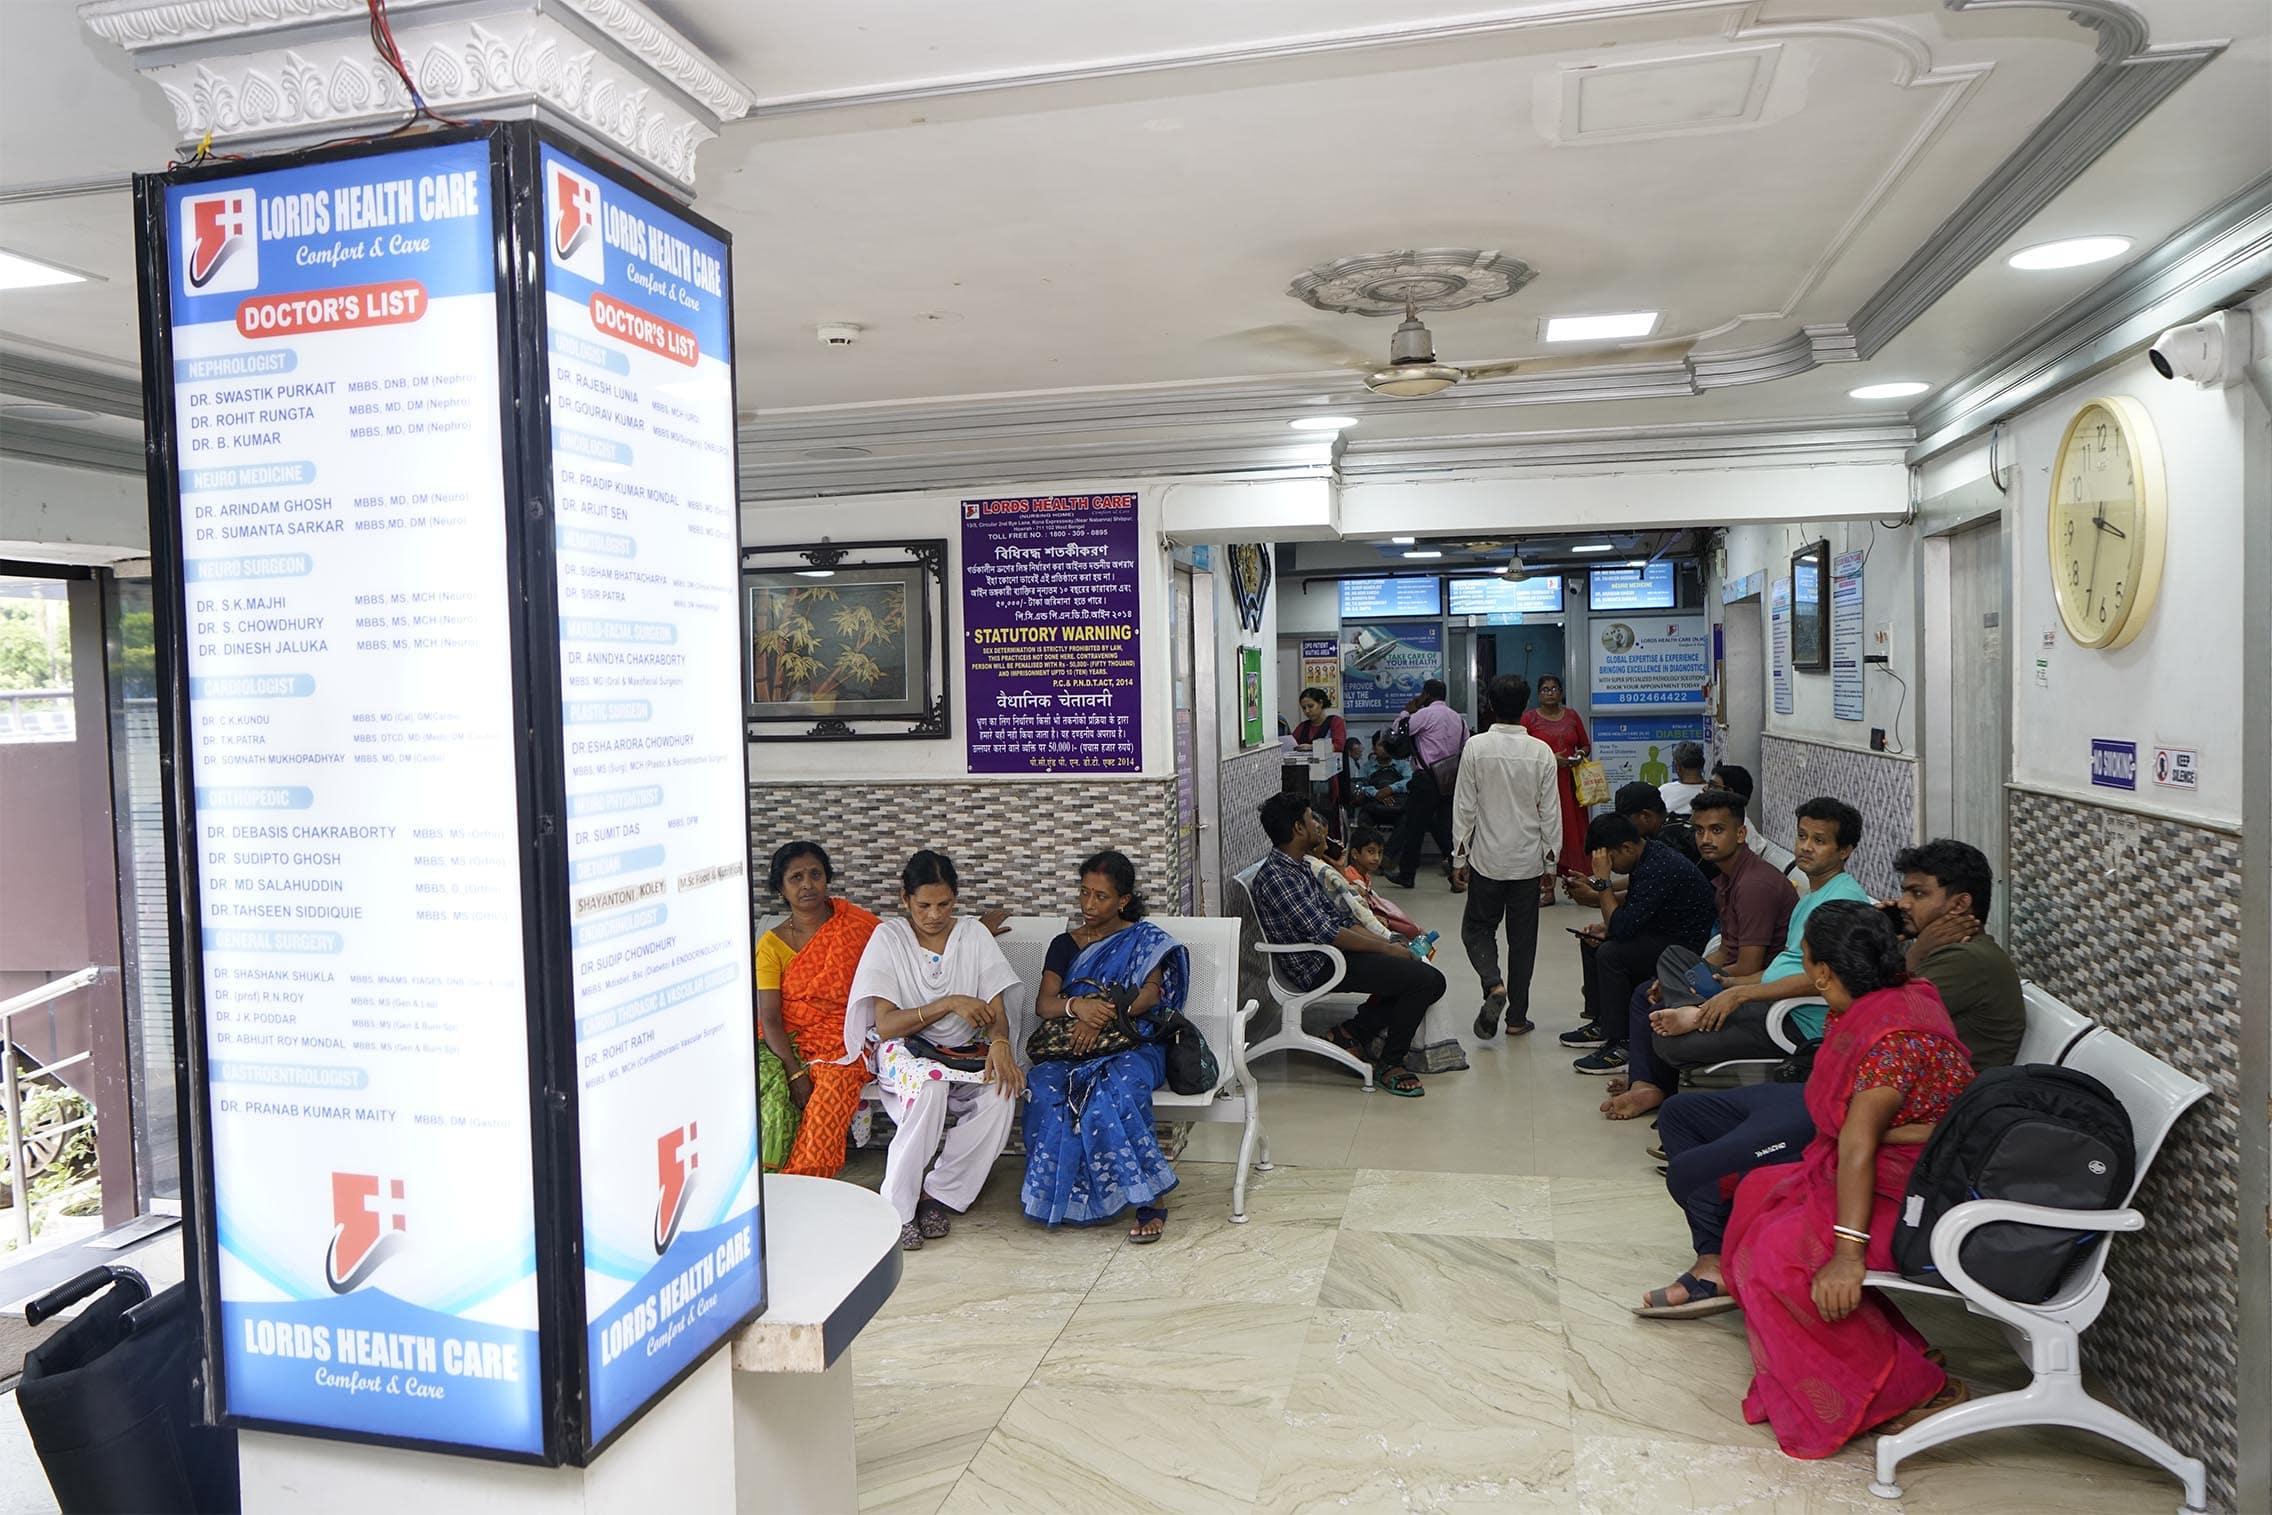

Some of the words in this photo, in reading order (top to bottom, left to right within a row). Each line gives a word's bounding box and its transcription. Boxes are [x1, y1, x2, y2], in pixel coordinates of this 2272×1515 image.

[261, 193, 329, 240] LORDS
[335, 179, 415, 232] HEALTH
[418, 171, 478, 221] CARE
[296, 242, 364, 267] Comfort
[369, 238, 384, 258] &
[389, 234, 430, 257] Care
[603, 201, 646, 260] LORDS
[648, 225, 691, 281] HEALTH
[693, 249, 721, 297] CARE
[627, 263, 666, 296] Comfort
[669, 287, 676, 300] &
[679, 288, 700, 312] Care
[245, 295, 359, 331] DOCTOR'S
[367, 290, 419, 318] LIST
[595, 300, 664, 348] DOCTOR'S
[668, 330, 695, 359] LIST
[189, 354, 285, 378] NEPHROLOGIST
[190, 393, 211, 406] DR.
[216, 389, 273, 404] SWASTIK
[277, 381, 336, 399] PURKAIT
[557, 367, 571, 382] DR.
[576, 373, 611, 394] RAJESH
[614, 385, 638, 404] LUNIA
[191, 416, 212, 429] DR.
[216, 412, 255, 427] ROHIT
[259, 407, 314, 424] RUNGTA
[192, 438, 213, 451] DR.
[217, 437, 229, 448] B.
[234, 432, 281, 447] KUMAR
[2097, 424, 2106, 452] 12
[2083, 443, 2090, 472] 11
[194, 466, 236, 488] NEURO
[240, 465, 303, 485] MEDICINE
[195, 506, 216, 518] DR.
[220, 502, 280, 517] ARINDAM
[284, 498, 332, 512] GHOSH
[983, 502, 1029, 514] LORDS
[1033, 497, 1088, 512] HEALTH
[1092, 495, 1131, 509] CARE
[197, 528, 218, 541] DR.
[222, 524, 283, 539] SUMANTA
[288, 520, 344, 535] SARKAR
[2068, 520, 2073, 545] 9
[199, 560, 240, 577] NEURO
[243, 557, 305, 575] SURGEON
[2072, 560, 2079, 586] 8
[2116, 581, 2122, 608] 5
[197, 600, 218, 612] DR.
[2100, 597, 2106, 623] 6
[198, 623, 218, 634] DR.
[223, 621, 234, 633] S.
[238, 617, 324, 632] CHOWDHURY
[975, 628, 1057, 644] STATUTORY
[1062, 625, 1132, 640] WARNING
[199, 644, 220, 656] DR.
[224, 642, 271, 655] DINESH
[275, 640, 327, 653] JALUKA
[569, 652, 584, 664] DR.
[587, 652, 624, 664] ANINDYA
[627, 653, 686, 665] CHAKRABORTY
[1629, 655, 1658, 663] EXPERTISE
[1665, 654, 1698, 662] EXPERIENCE
[1627, 665, 1660, 673] EXCELLENCE
[1349, 682, 1373, 690] PROVIDE
[997, 690, 1051, 708] वैधानिक
[1058, 689, 1112, 706] चेतावनी
[1355, 700, 1381, 708] SERVICES
[1620, 693, 1687, 702] 8902464422
[1656, 730, 1702, 738] DIABETE
[207, 827, 227, 838] DR.
[232, 827, 288, 838] DEBASIS
[292, 826, 396, 839] CHAKRABORTY
[209, 853, 228, 864] DR.
[233, 853, 289, 864] SUDIPTO
[293, 853, 341, 865] GHOSH
[210, 879, 230, 890] DR.
[235, 879, 253, 890] MD
[258, 879, 343, 892] SALAHUDDIN
[577, 887, 636, 911] SHAYANTONI
[639, 880, 664, 896] KOLEY
[221, 1100, 242, 1112] DR.
[246, 1102, 299, 1116] PRANAB
[303, 1106, 351, 1119] KUMAR
[355, 1109, 396, 1122] MAITY
[601, 1295, 657, 1367] LORDS
[660, 1253, 714, 1323] HEALTH
[716, 1225, 751, 1278] CARE
[646, 1318, 686, 1356] Comfort
[687, 1305, 696, 1326] &
[698, 1294, 718, 1317] Care
[245, 1320, 332, 1361] LORDS
[337, 1330, 437, 1372] HEALTH
[444, 1342, 518, 1381] CARE
[315, 1370, 382, 1394] Comfort
[386, 1375, 400, 1394] &
[405, 1377, 445, 1399] Care
